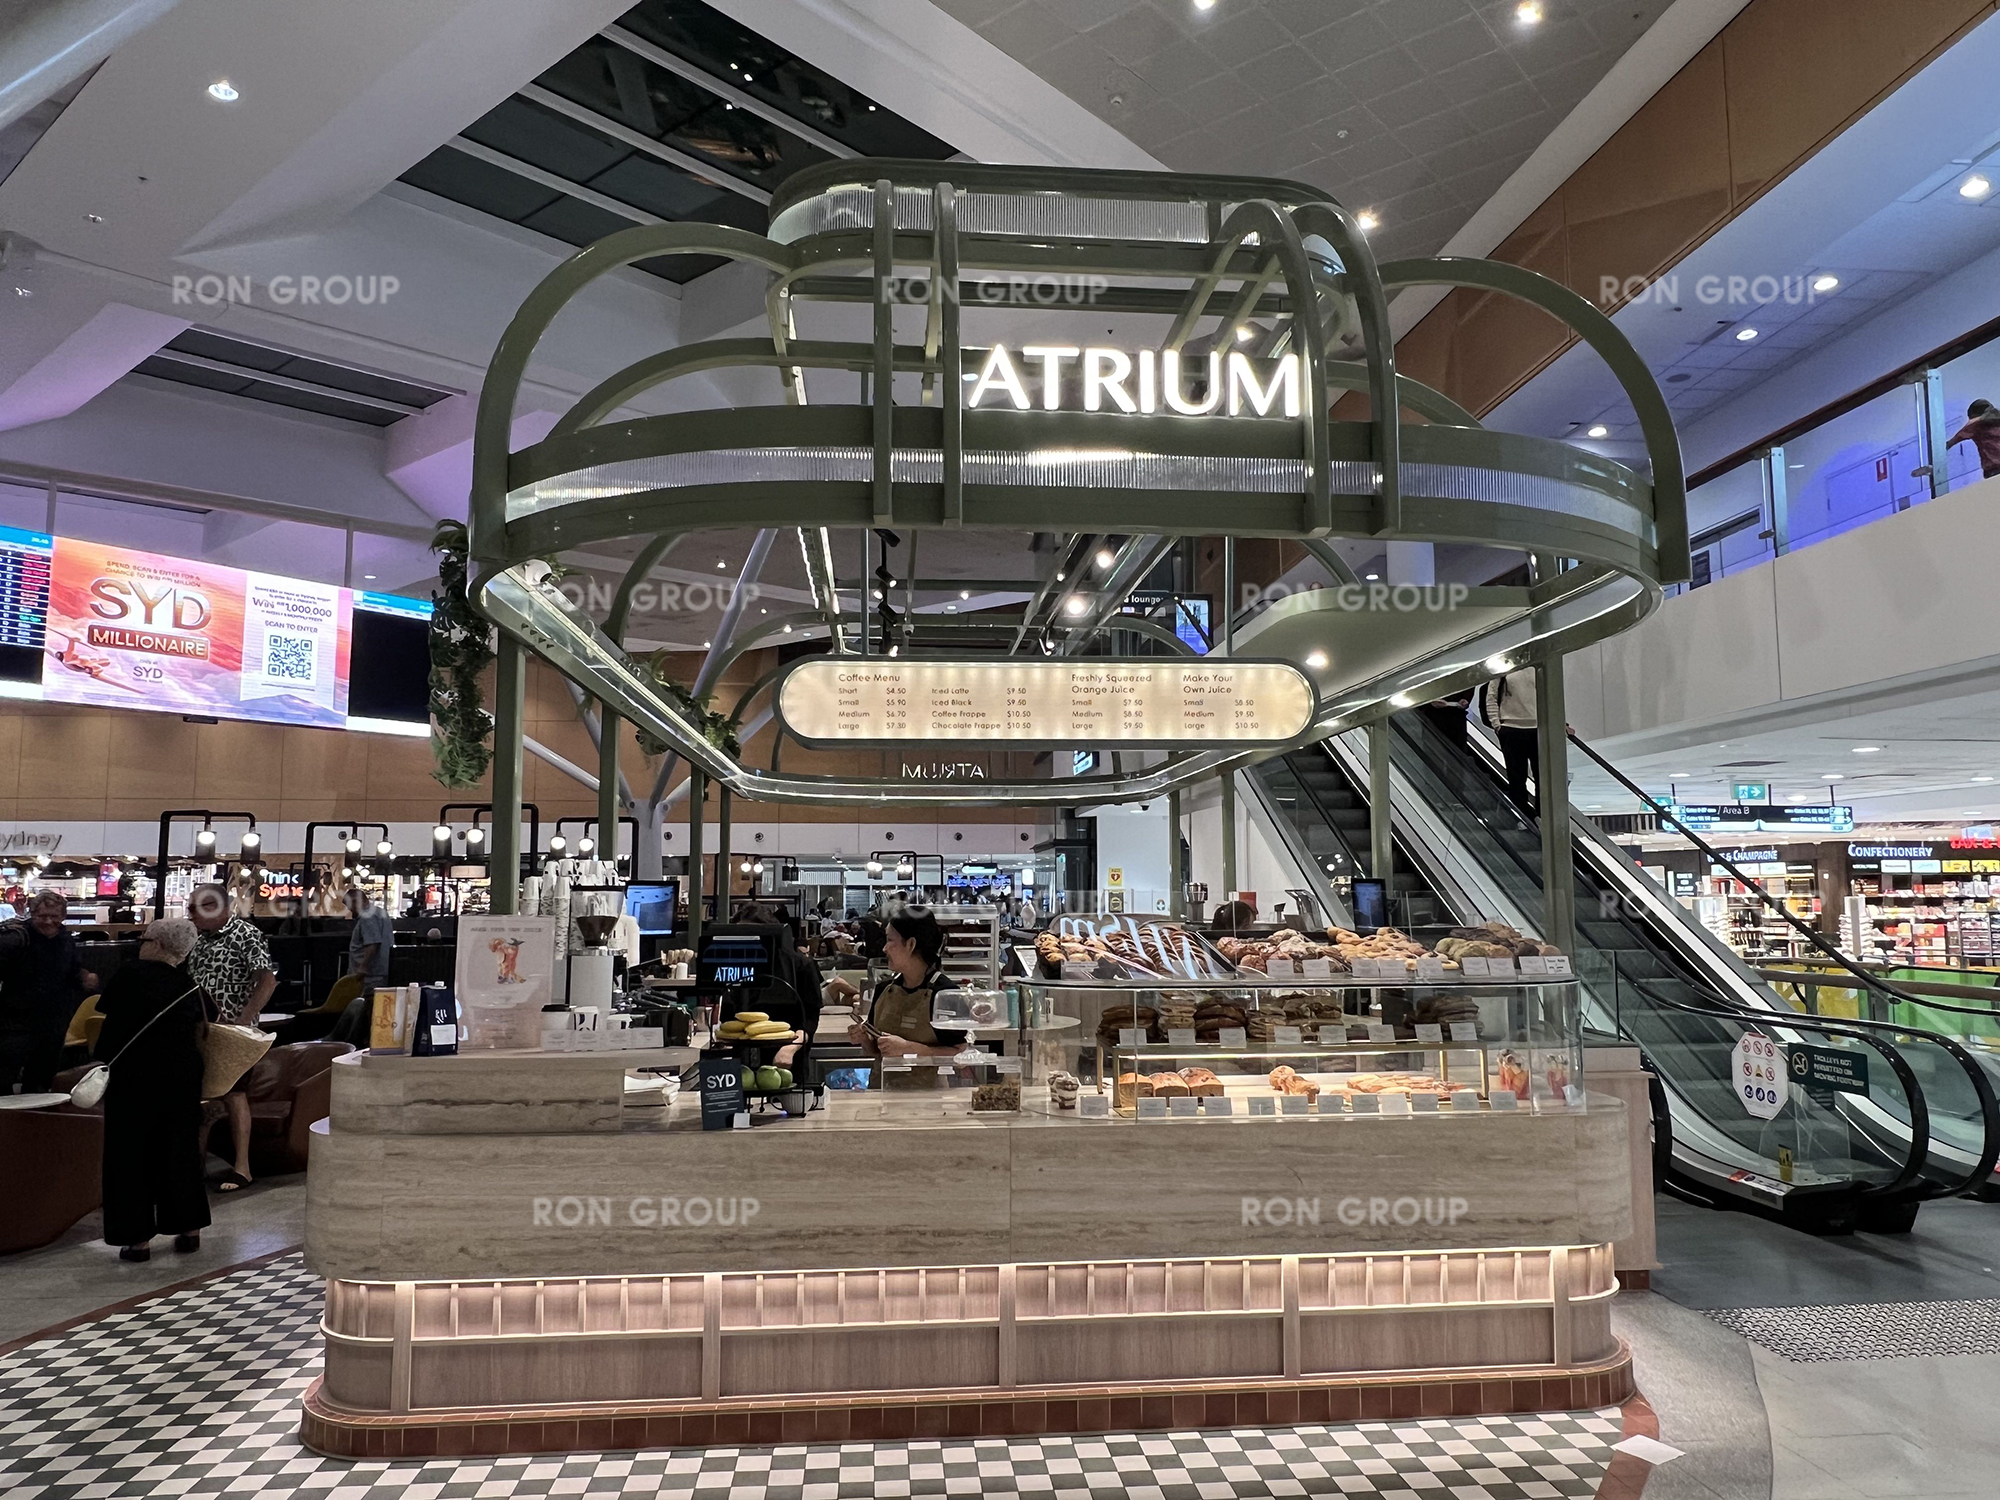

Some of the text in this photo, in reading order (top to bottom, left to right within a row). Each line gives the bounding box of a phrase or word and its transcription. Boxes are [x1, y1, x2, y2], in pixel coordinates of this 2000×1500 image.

[967, 343, 1301, 419] ATRIUM
[90, 577, 212, 630] SYD
[1131, 595, 1164, 605] lounge
[265, 620, 285, 629] SCAN
[93, 629, 206, 656] MILLIONAIRE
[133, 666, 163, 679] SYD
[838, 674, 900, 682] Coffee Menu
[1072, 674, 1152, 683] Freshly Squeezed
[1212, 674, 1233, 682] Your
[1072, 686, 1107, 695] Orange
[1723, 806, 1742, 815] Area
[1743, 806, 1750, 815] B
[0, 831, 62, 851] ydney
[706, 1074, 736, 1089] SYD
